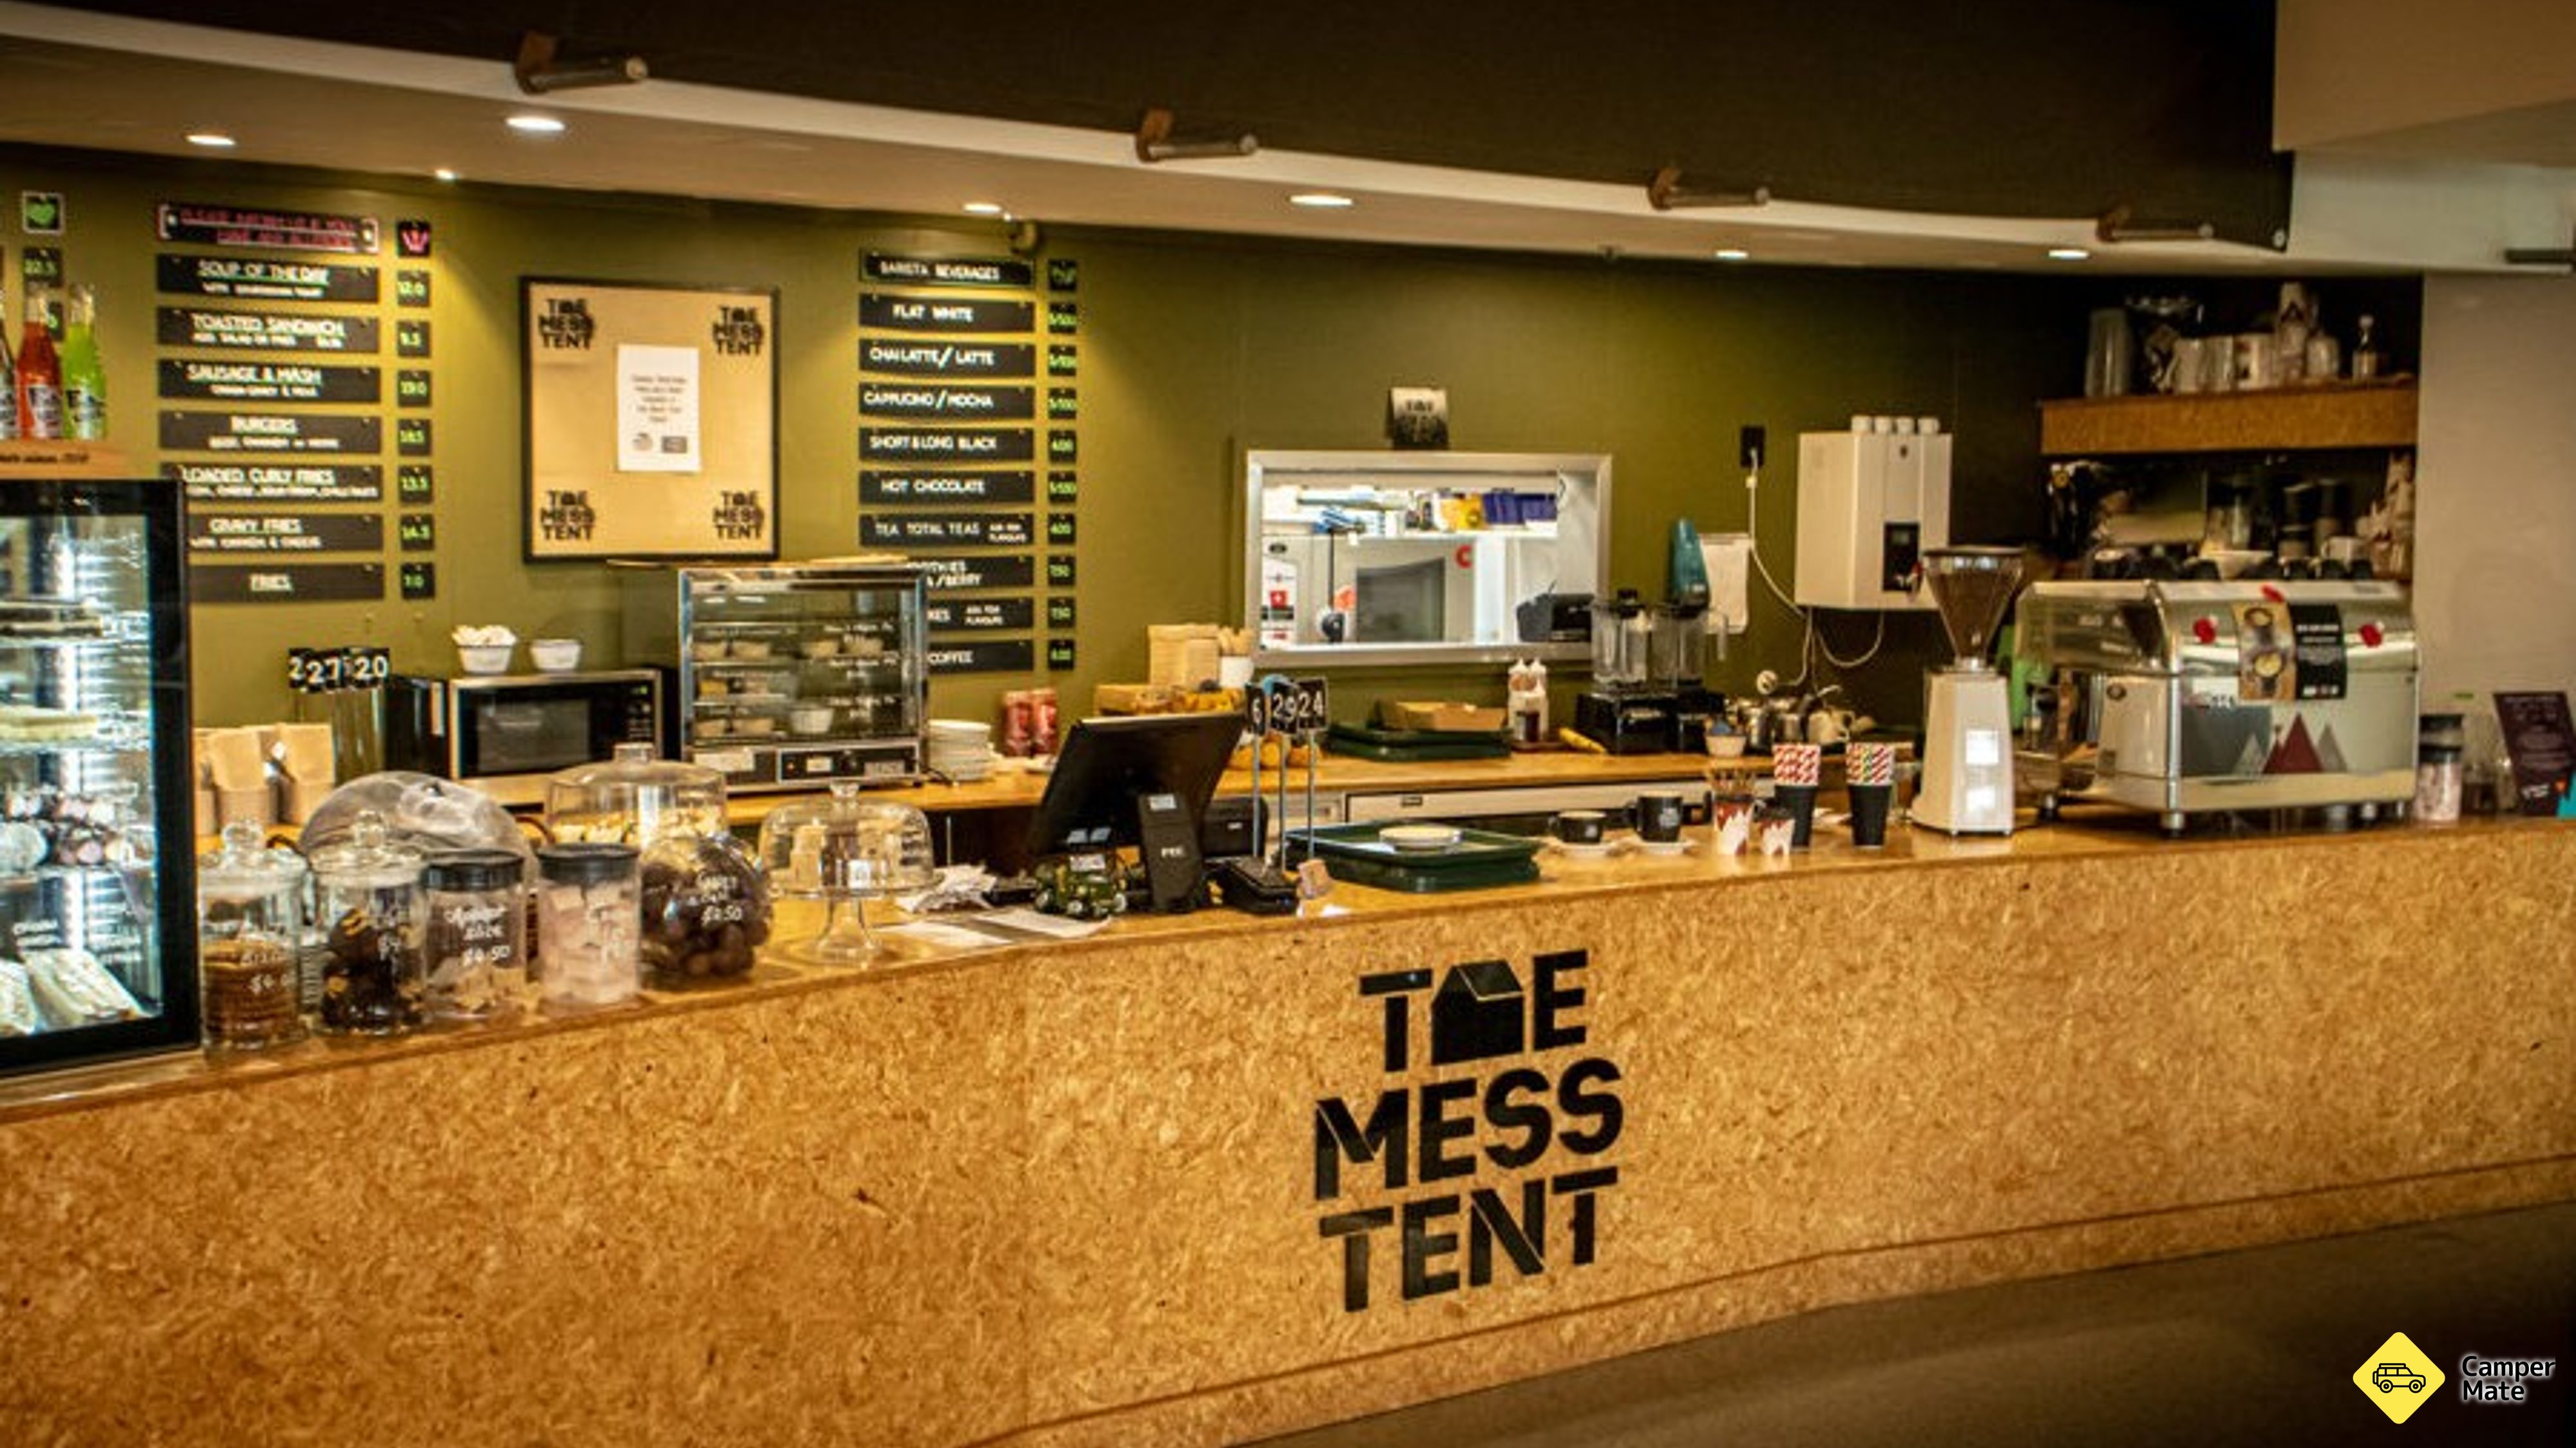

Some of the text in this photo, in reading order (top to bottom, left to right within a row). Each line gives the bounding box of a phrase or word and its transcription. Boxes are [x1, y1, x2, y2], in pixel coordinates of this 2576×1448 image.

[198, 260, 242, 278] SOUP
[244, 262, 264, 279] OF
[879, 260, 1001, 281] BARISTA BEVERAGES
[893, 303, 974, 323] FLAT WHITE
[191, 312, 346, 339] TOASTED SANDWICH
[538, 314, 596, 336] MESS
[712, 322, 764, 343] MESS
[542, 332, 591, 350] TENT
[715, 340, 762, 356] TENT
[955, 350, 995, 366] LATTE
[186, 365, 257, 383] SAUSAGE
[276, 368, 322, 386] MASH
[230, 415, 298, 435] BURGERS
[870, 434, 910, 450] SHORT
[920, 436, 954, 450] LONG
[958, 436, 996, 450] BLACK
[180, 467, 337, 486] LOADED CURLY FRIES
[880, 479, 985, 495] HOT CHOCOLATE
[208, 518, 303, 535] GRAVY FRIES
[540, 506, 596, 528] MESS
[712, 506, 764, 528] MESS
[544, 524, 592, 541] TENT
[715, 524, 762, 540] TENT
[875, 522, 980, 536] TEA TOTAL TEAS
[249, 573, 294, 593] FRIES
[354, 654, 388, 679] 20
[927, 651, 974, 664] COFFEE
[1298, 690, 1324, 718] 24
[1314, 1057, 1624, 1201] MESS
[1319, 1165, 1618, 1313] TENT
